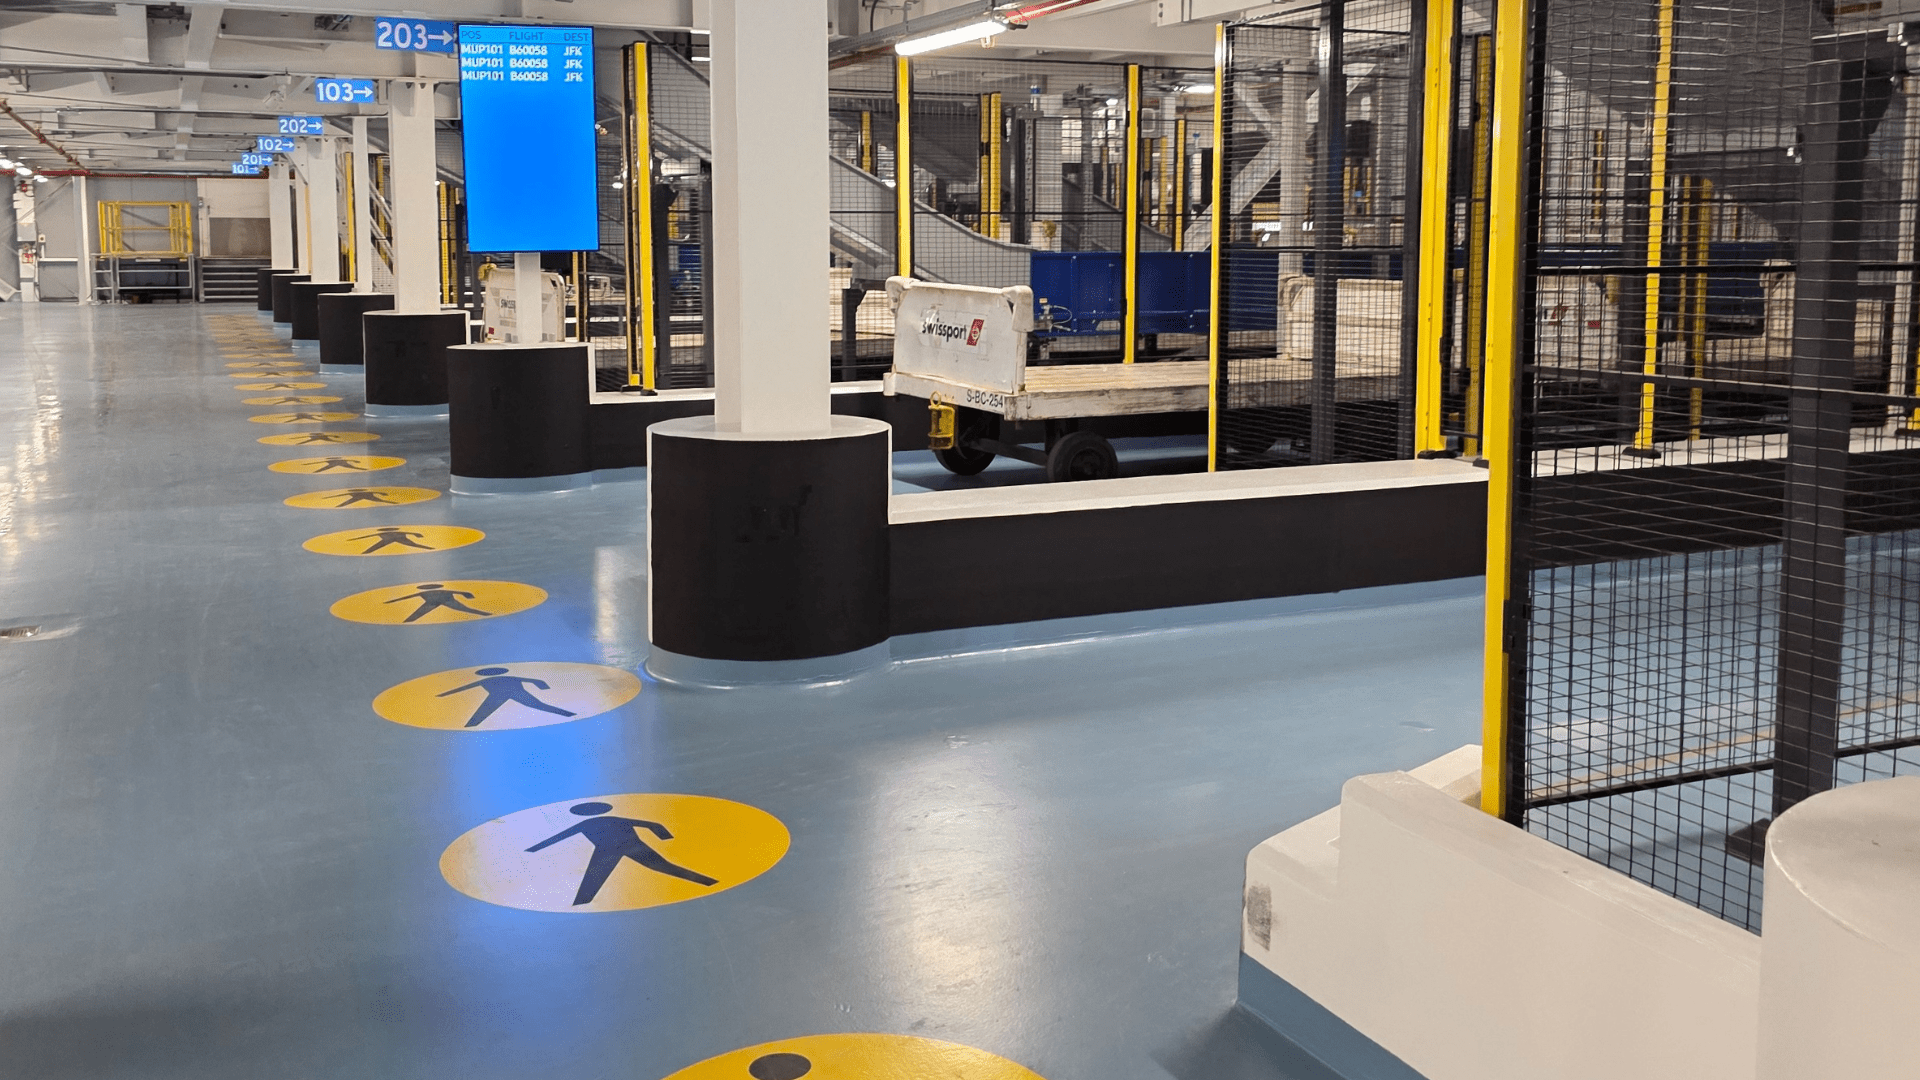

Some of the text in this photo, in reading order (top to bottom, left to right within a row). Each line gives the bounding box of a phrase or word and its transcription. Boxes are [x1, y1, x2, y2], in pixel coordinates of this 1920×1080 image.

[377, 22, 428, 49] 203
[461, 30, 589, 42] POS FLIGHT DEST
[460, 43, 583, 56] MUP101 B60058 JFK
[461, 56, 583, 69] MUP101 B60058 JFK
[461, 70, 584, 82] MUP101 B60058 JFK
[317, 82, 354, 101] 103
[279, 119, 308, 134] 202
[257, 138, 283, 151] 102
[241, 153, 263, 165] 201
[232, 163, 250, 174] 101
[922, 318, 967, 342] swissport
[966, 389, 1003, 408] S-BC-254
